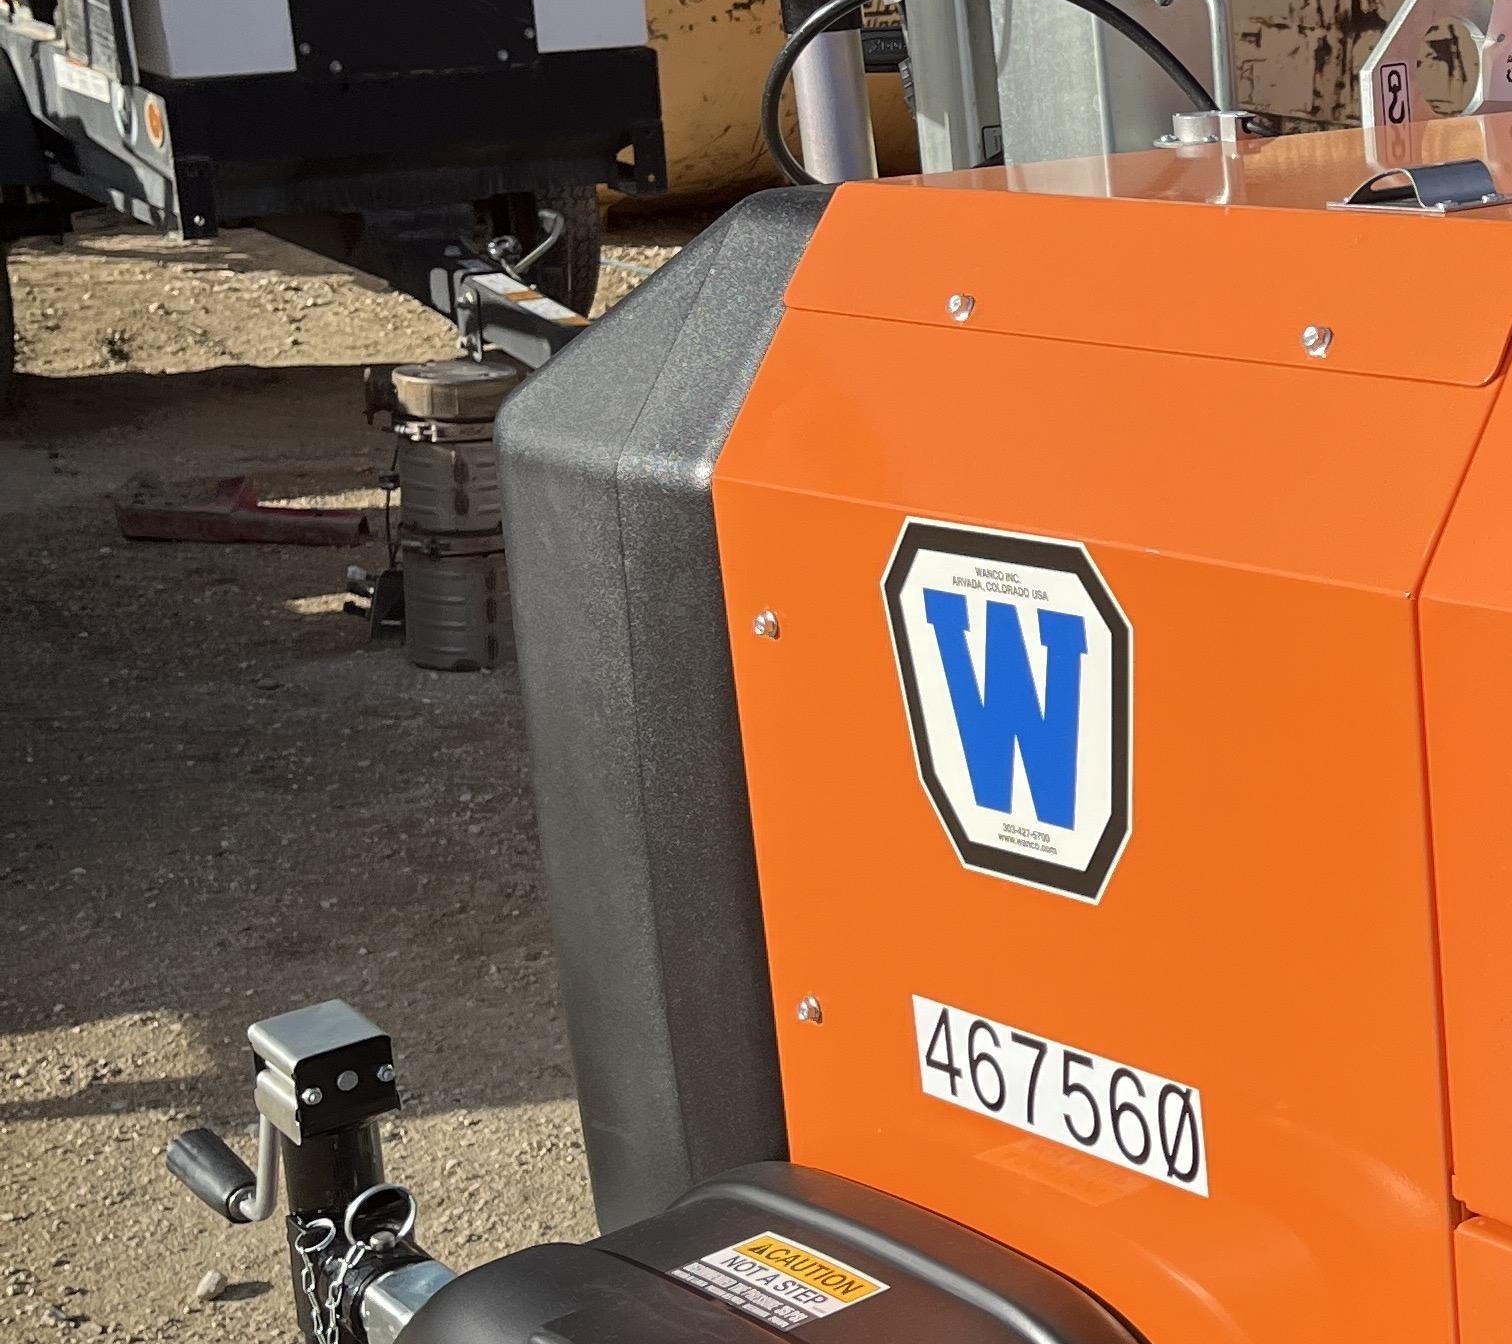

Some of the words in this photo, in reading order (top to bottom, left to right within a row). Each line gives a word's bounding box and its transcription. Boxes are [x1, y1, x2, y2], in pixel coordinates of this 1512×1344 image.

[952, 576, 985, 593] ARVADA,
[986, 581, 1030, 600] COLORADO
[1031, 589, 1049, 602] USA
[975, 566, 1004, 582] WANCO
[1005, 572, 1021, 584] INC.
[922, 587, 1089, 832] W
[998, 832, 1058, 855] www.wanco.com
[720, 1255, 759, 1276] NOT
[756, 1270, 775, 1286] A
[772, 1278, 830, 1307] STEP
[765, 1244, 865, 1296] CAUTION
